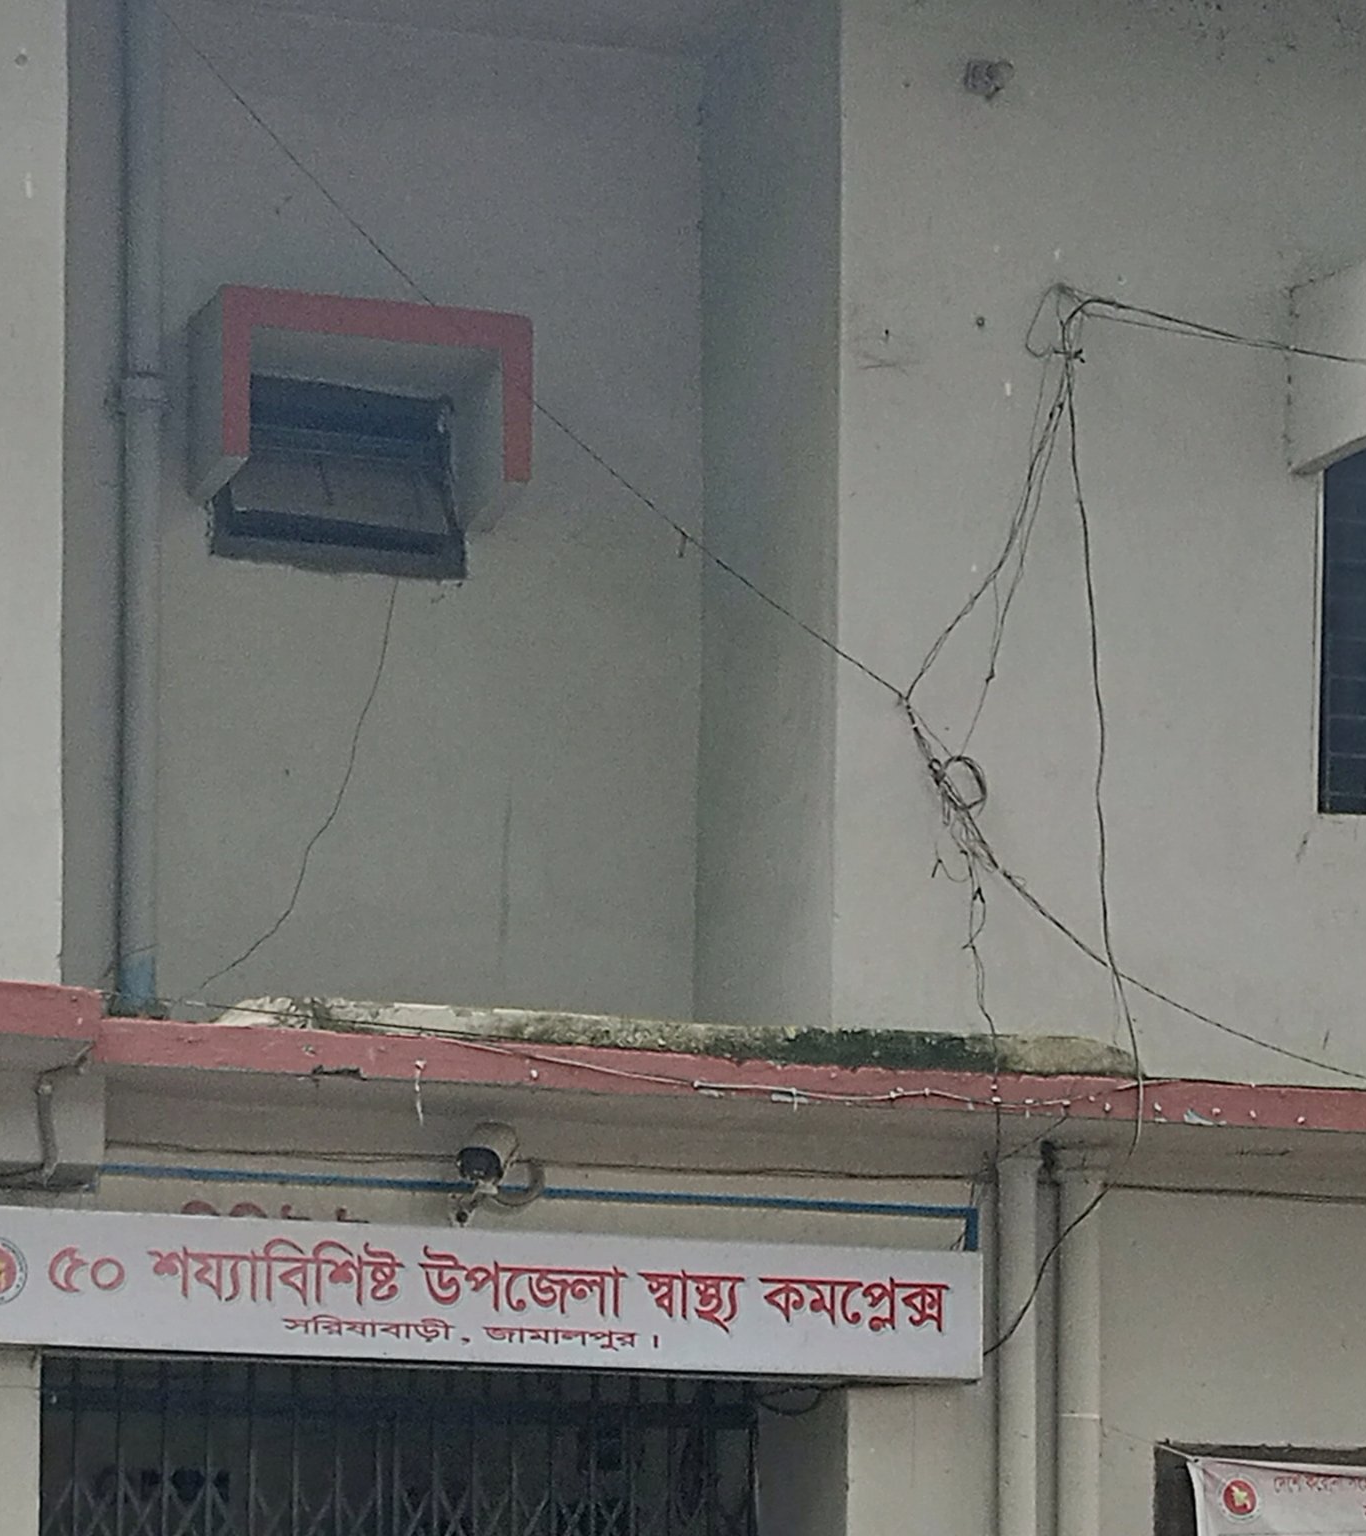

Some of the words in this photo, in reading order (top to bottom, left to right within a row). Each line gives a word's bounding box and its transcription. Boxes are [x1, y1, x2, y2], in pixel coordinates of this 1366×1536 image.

[48, 1246, 126, 1294] ৫০
[147, 1236, 404, 1306] শয্যাবিশিষ্ট
[418, 1245, 628, 1318] উপজেলা
[638, 1269, 745, 1334] স্বাস্থ্য
[758, 1276, 950, 1333] কমপ্লেক্স
